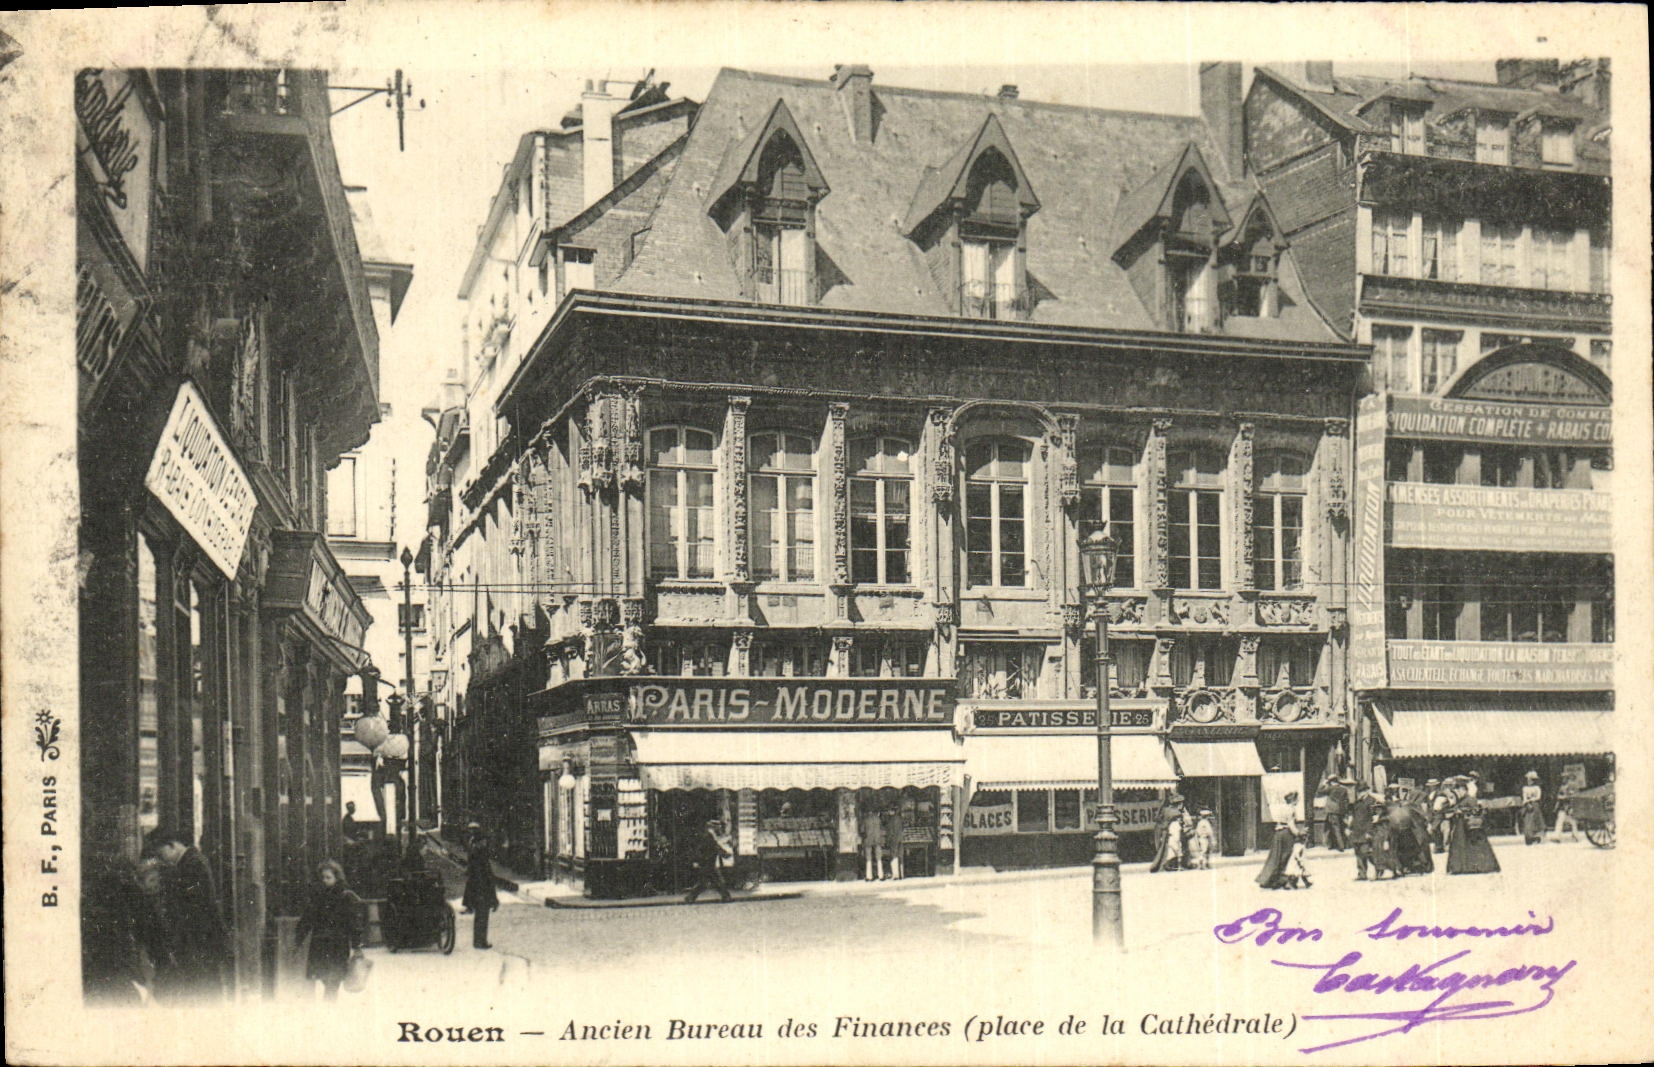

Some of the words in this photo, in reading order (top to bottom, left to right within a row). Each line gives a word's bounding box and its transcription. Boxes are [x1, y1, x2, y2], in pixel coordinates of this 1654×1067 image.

[1430, 400, 1522, 417] CESSATION
[1529, 406, 1551, 417] DE
[1546, 421, 1591, 441] RABAIS
[173, 396, 229, 499] LIQUIDATION
[1435, 507, 1477, 520] POUR
[1357, 481, 1380, 611] LIQUIDATION
[586, 699, 621, 715] ARRAS
[998, 711, 1133, 726] PATISSEIE
[962, 809, 1013, 830] GLACES
[1214, 907, 1323, 946] Bon
